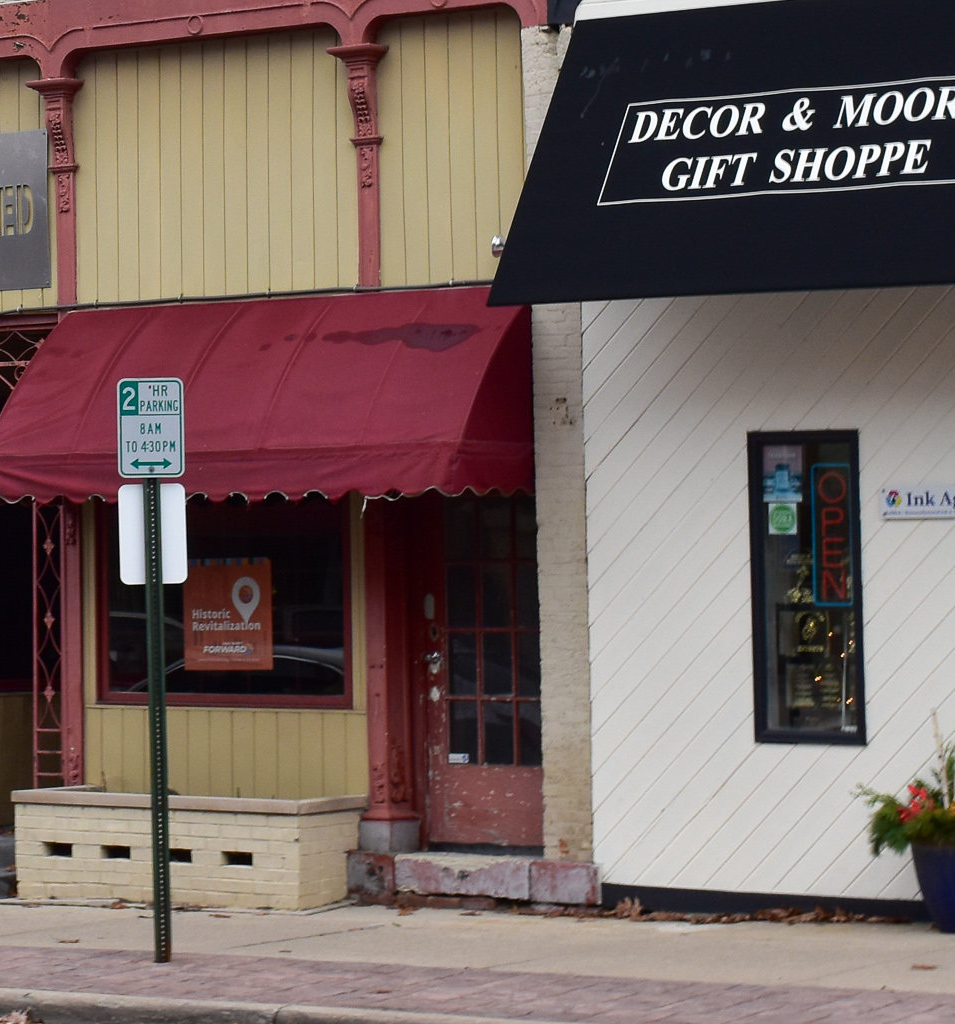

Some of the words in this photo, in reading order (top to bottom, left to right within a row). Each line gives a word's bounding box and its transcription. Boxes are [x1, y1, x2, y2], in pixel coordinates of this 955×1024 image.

[628, 102, 766, 144] DECOR
[781, 96, 816, 132] &
[661, 152, 758, 191] GIFT
[768, 138, 932, 184] SHOPPE
[152, 384, 168, 397] HR
[122, 386, 136, 411] 2
[139, 399, 179, 412] PARKING
[125, 440, 138, 453] TO
[906, 490, 935, 507] Ink
[940, 490, 955, 511] A
[817, 470, 847, 600] OPEN
[192, 608, 231, 620] Historic
[192, 620, 261, 632] Revitalization
[203, 645, 247, 654] FORWARD
